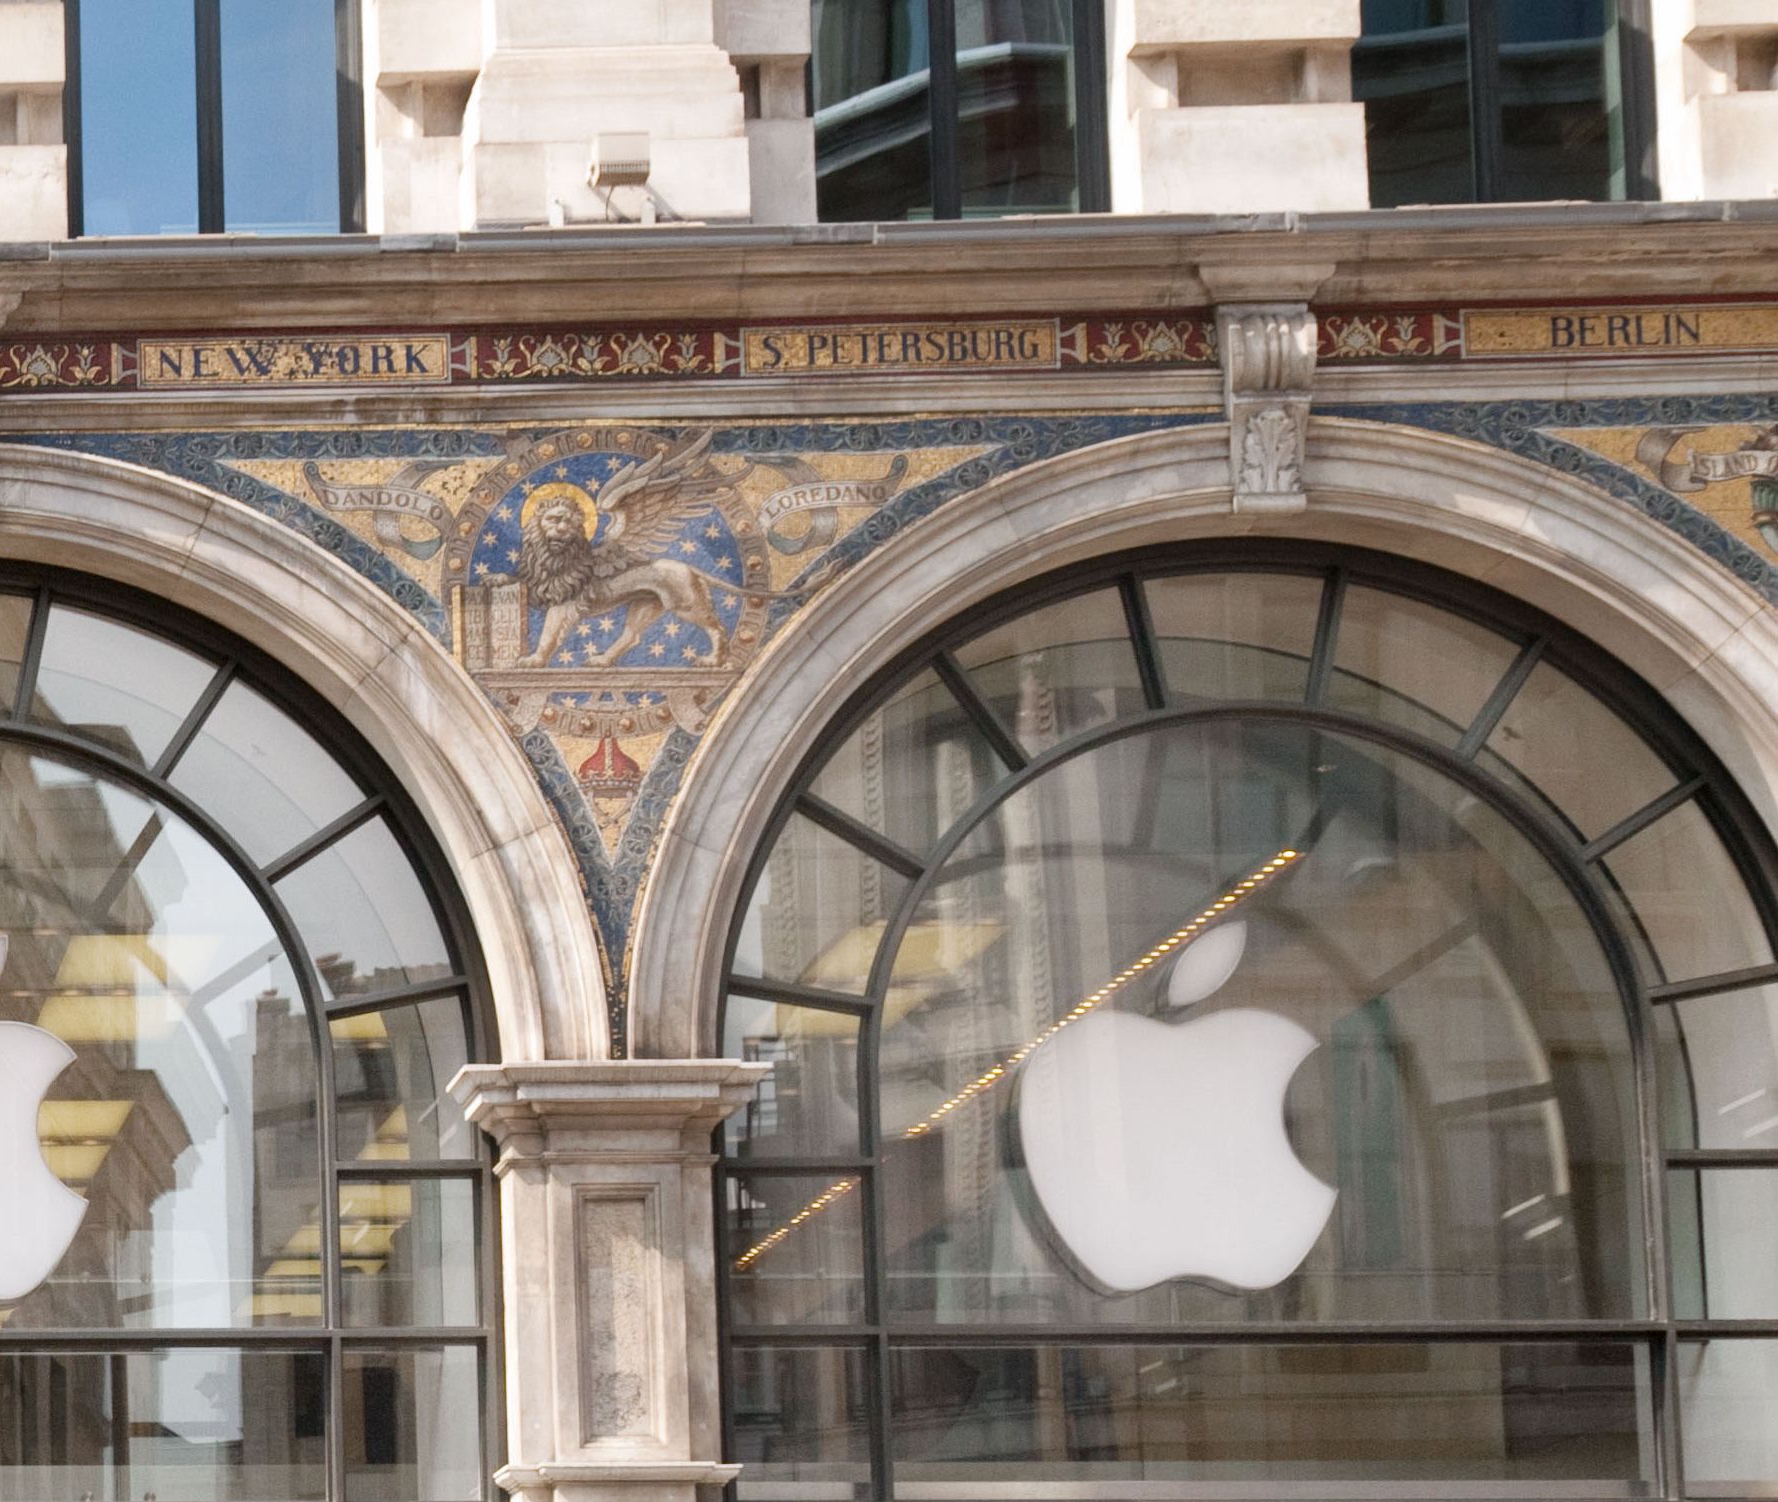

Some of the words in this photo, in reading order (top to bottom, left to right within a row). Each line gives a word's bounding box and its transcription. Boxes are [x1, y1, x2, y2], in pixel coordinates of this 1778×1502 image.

[807, 329, 1039, 365] PETERSBURG
[1550, 313, 1701, 347] BERLIN
[159, 346, 274, 378] NEW
[303, 342, 429, 376] YORK
[324, 490, 443, 520] DANDOLO
[765, 486, 886, 518] LOREDANO
